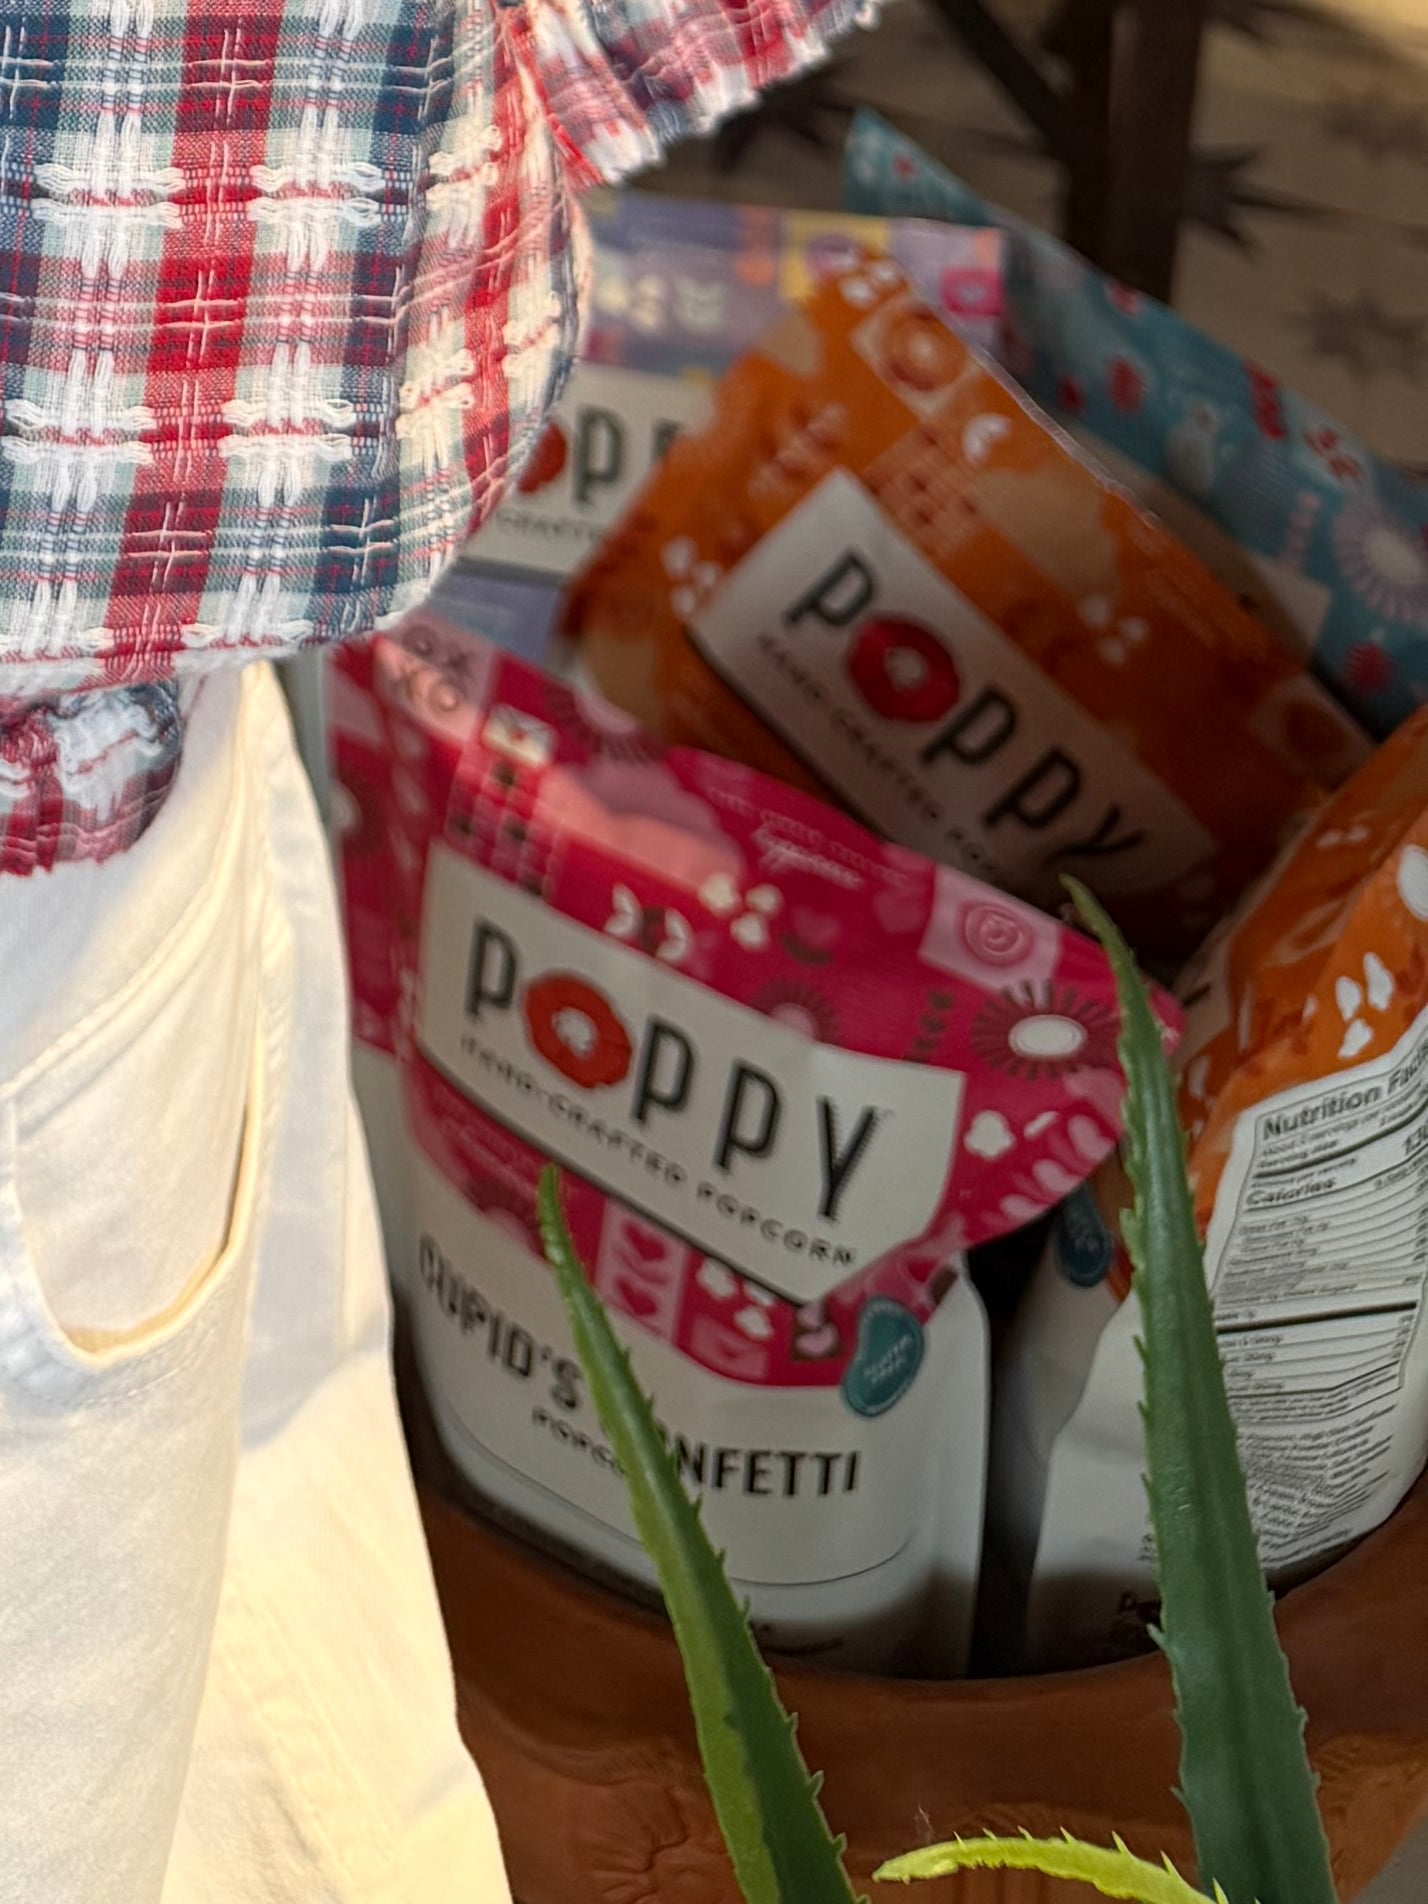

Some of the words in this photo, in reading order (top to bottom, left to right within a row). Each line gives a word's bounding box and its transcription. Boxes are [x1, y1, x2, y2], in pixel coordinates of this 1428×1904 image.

[1262, 1085, 1383, 1141] Nutrition
[696, 1180, 857, 1268] POPCORN
[418, 1234, 585, 1411] CUPID'S
